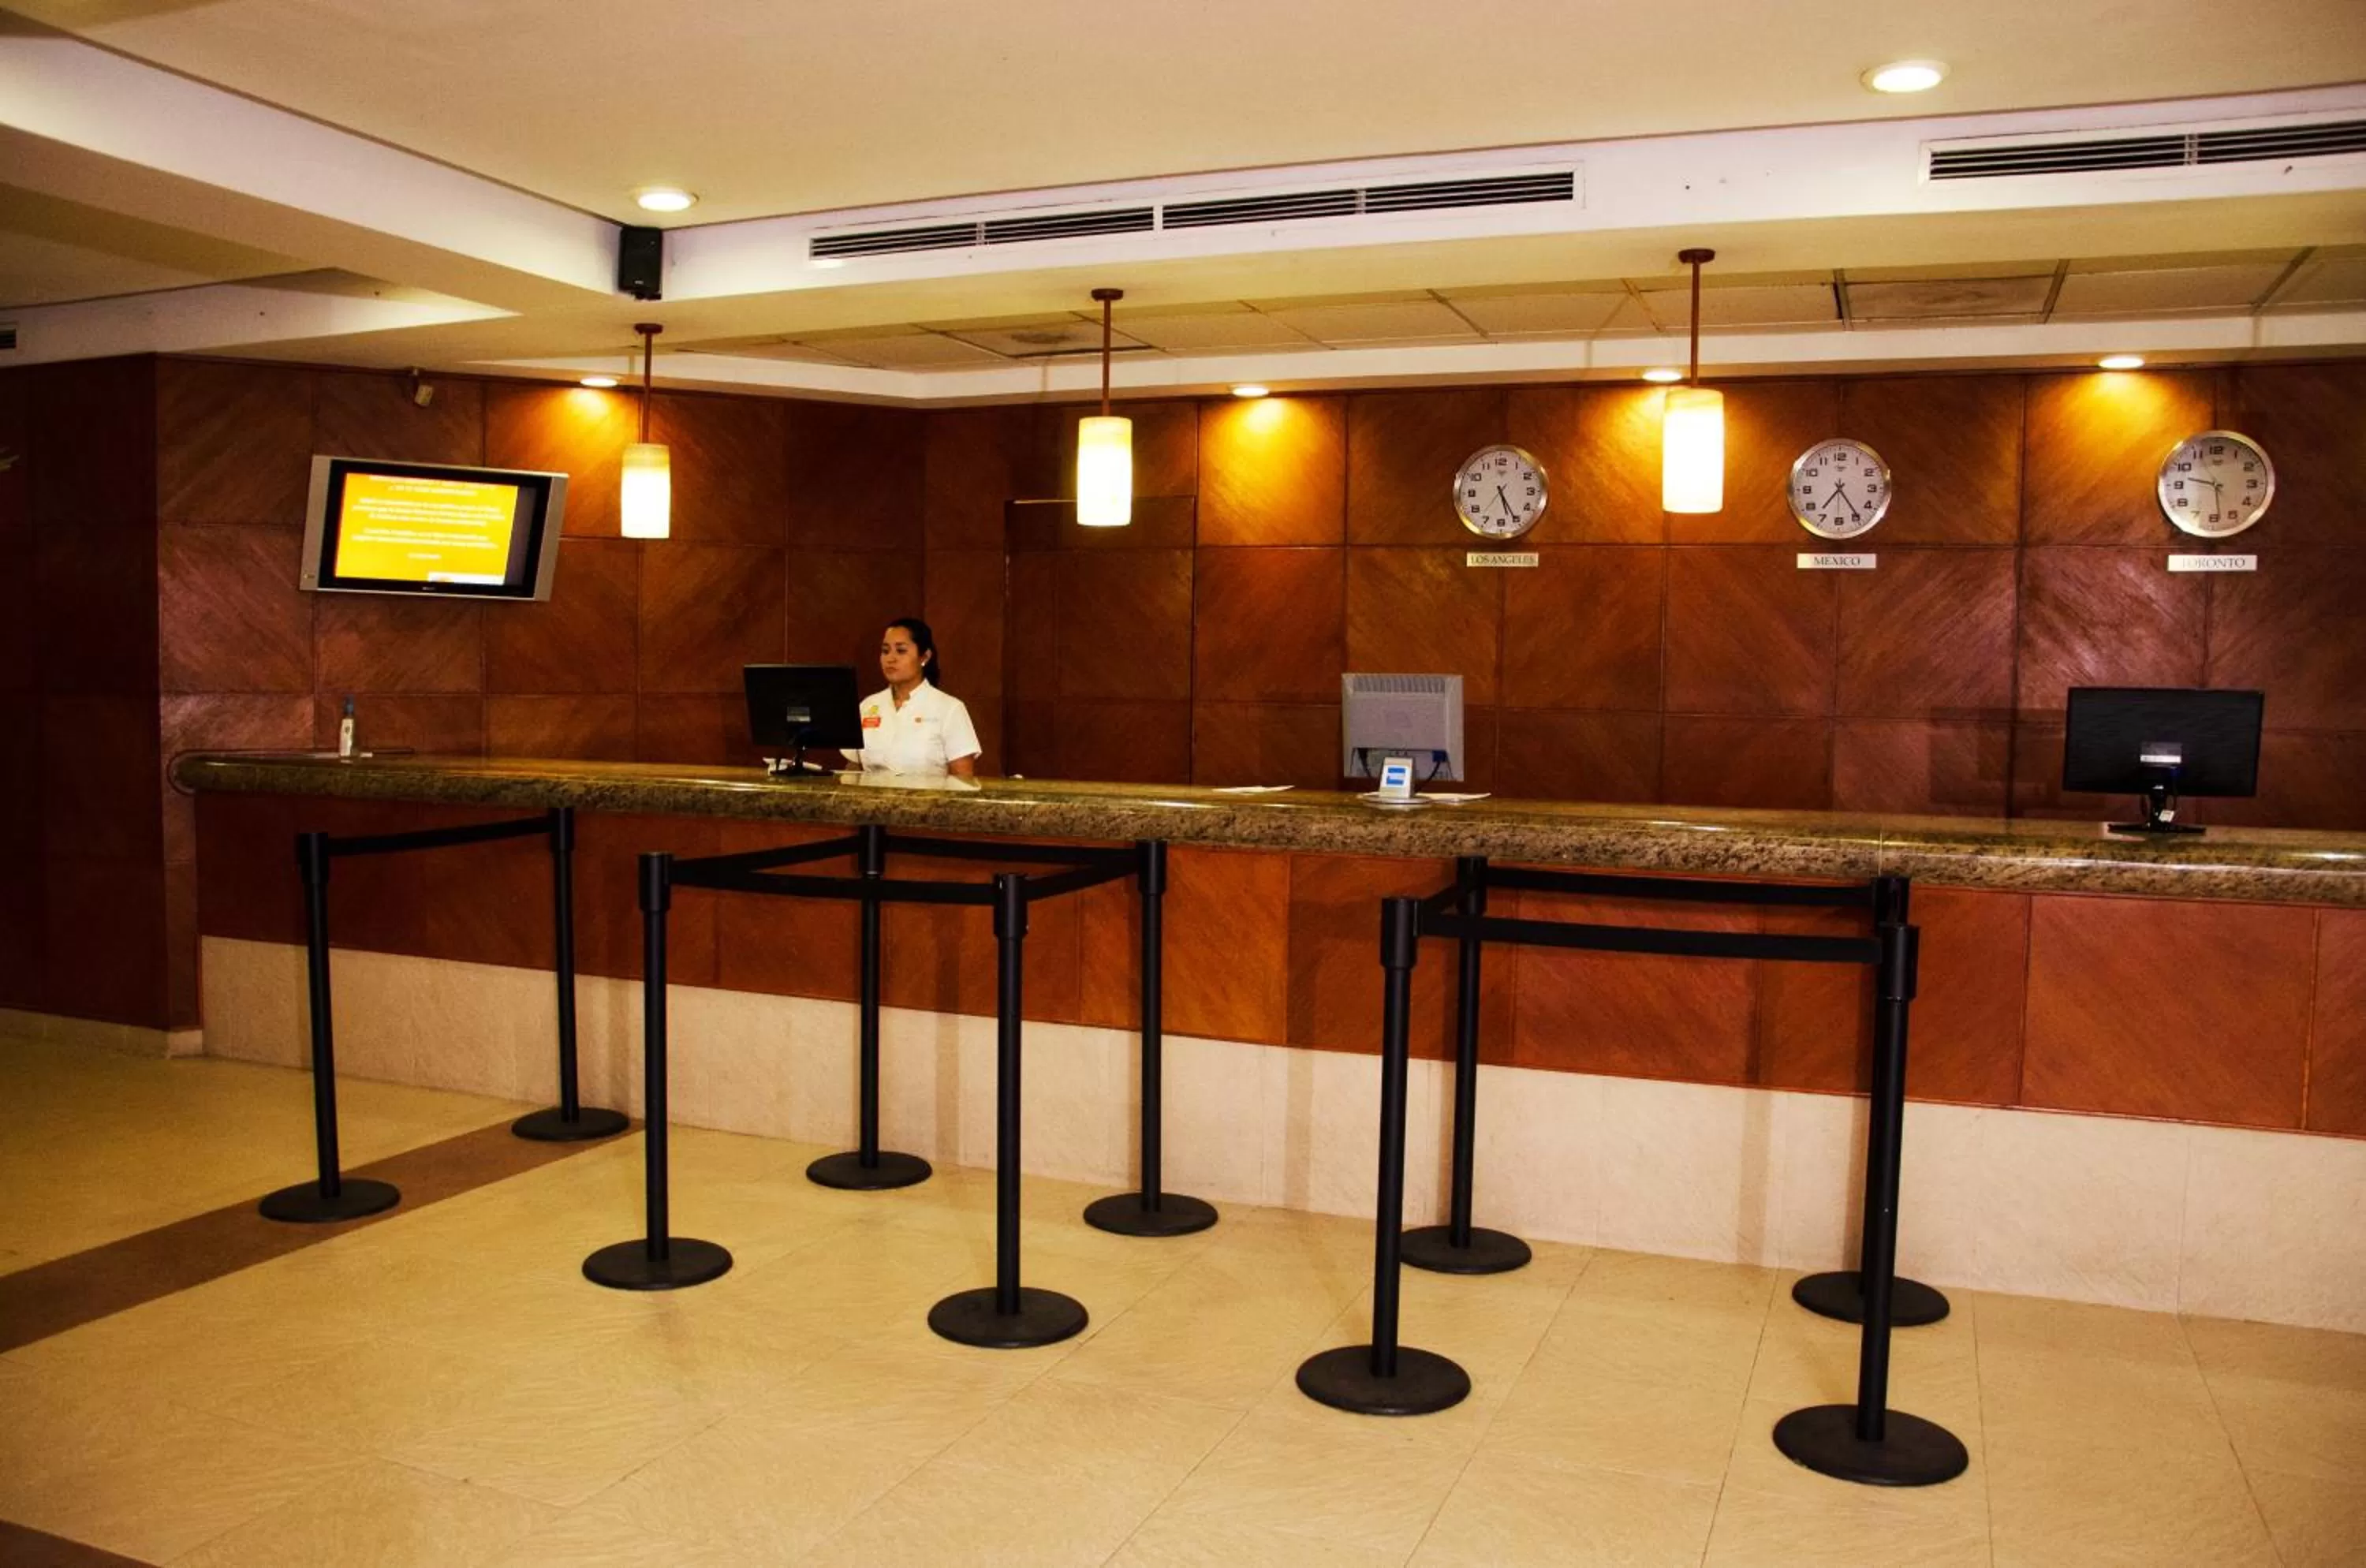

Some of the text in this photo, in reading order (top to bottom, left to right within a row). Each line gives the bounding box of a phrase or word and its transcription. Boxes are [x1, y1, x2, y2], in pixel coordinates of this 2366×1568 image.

[2193, 450, 2203, 459] 11
[2210, 446, 2224, 454] 12
[2178, 463, 2192, 472] 10
[1868, 484, 1877, 493] 3
[2246, 480, 2257, 488] 3
[1527, 487, 1535, 496] 3
[2242, 496, 2251, 506] 4
[1471, 555, 1535, 564] LOS ANGELES
[1814, 557, 1860, 566] MEXICO
